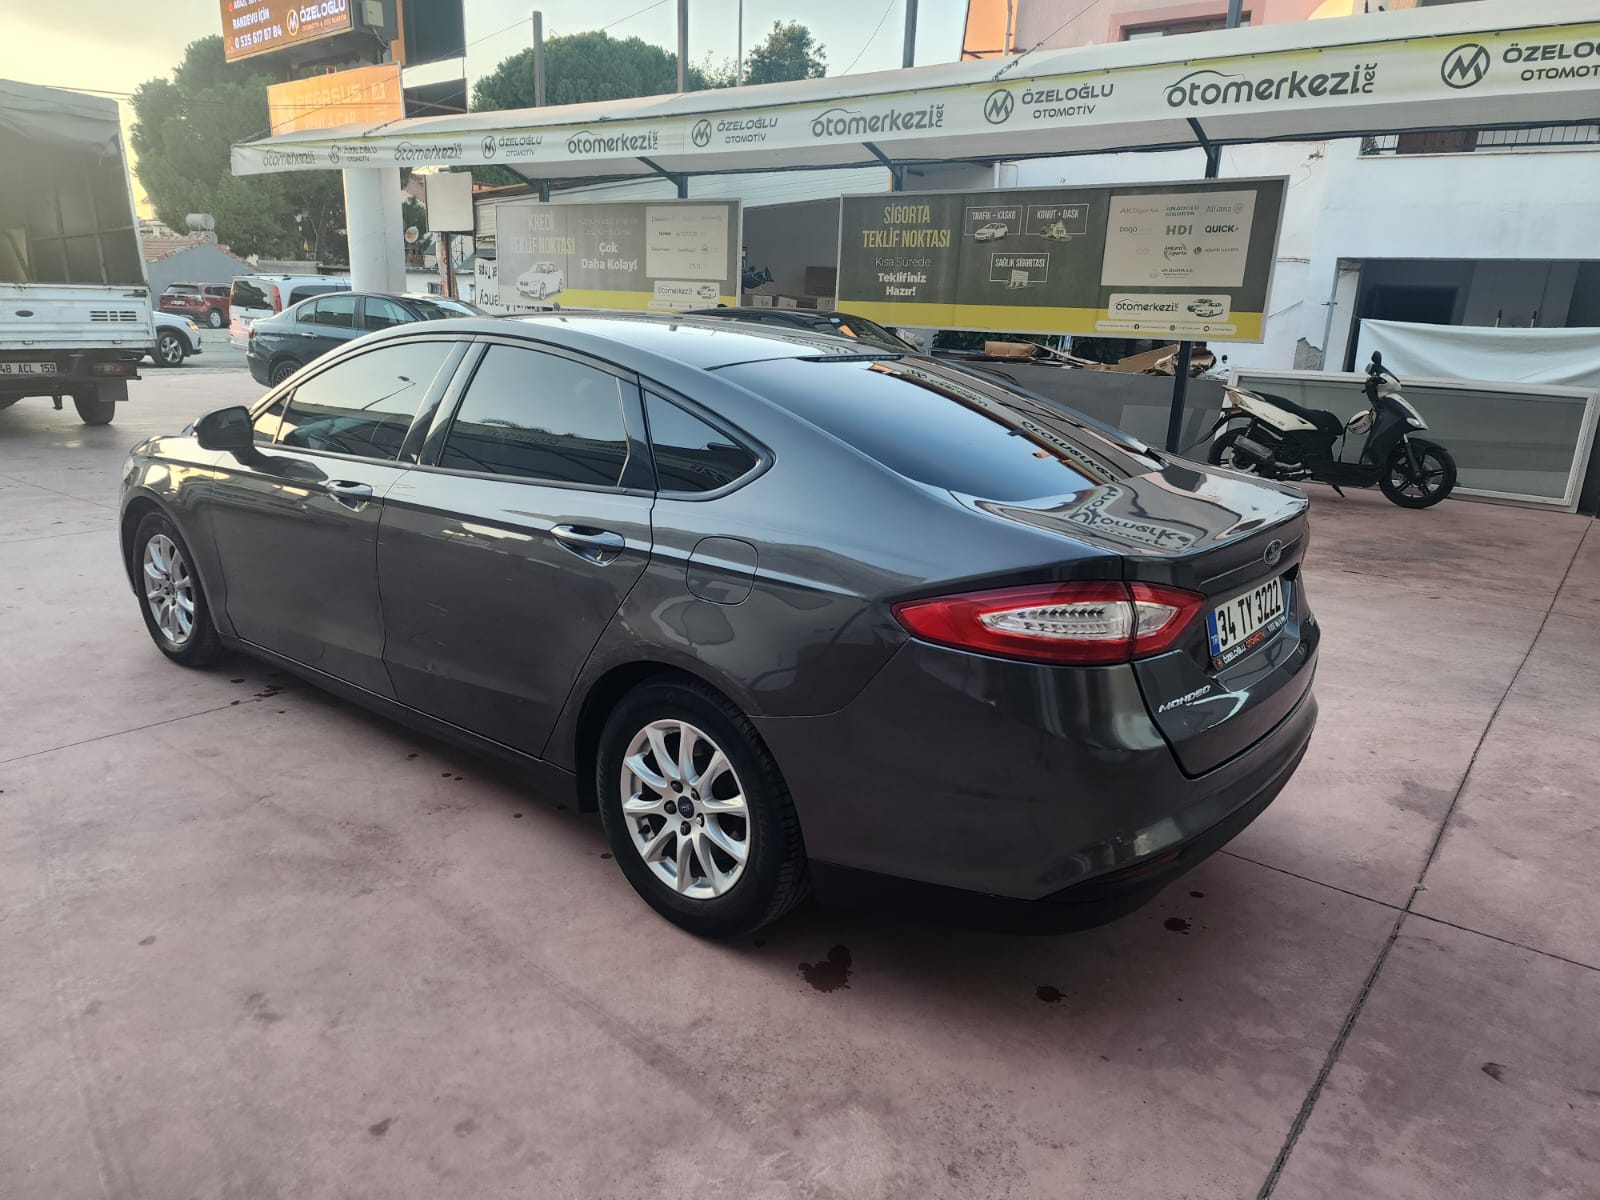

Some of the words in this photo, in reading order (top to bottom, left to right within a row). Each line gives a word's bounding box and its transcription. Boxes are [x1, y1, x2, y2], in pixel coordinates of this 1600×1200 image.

[240, 33, 252, 47] 535
[252, 28, 263, 43] 617
[272, 24, 282, 37] 84
[1503, 41, 1600, 64] ÖZELO
[1022, 82, 1114, 105] ÖZELOĞLU
[1032, 104, 1096, 119] OTOMOTİV
[717, 117, 779, 132] ÖZELOĞLU
[498, 136, 543, 147] ÖZELOĞLU
[725, 133, 766, 144] OTOMOTİV
[528, 211, 554, 231] KREDİ
[883, 203, 931, 224] SİGORTA
[1166, 225, 1193, 236] HDI
[1205, 225, 1235, 233] QUICK
[862, 227, 899, 248] TEKLİF
[901, 229, 951, 248] NOKTASI
[540, 236, 576, 256] NOKTASI
[599, 242, 618, 256] Çok
[581, 258, 605, 270] Daha
[607, 258, 638, 273] Kolay!
[875, 256, 894, 267] Kısa
[896, 256, 932, 267] Sürede
[878, 271, 927, 283] Teklifiniz
[885, 286, 917, 296] Hazır!
[18, 364, 36, 373] ACL
[40, 363, 56, 373] 159
[1217, 606, 1237, 647] 34
[1237, 594, 1253, 635] TY
[1255, 579, 1281, 625] 3222
[1158, 684, 1211, 713] MONDEO
